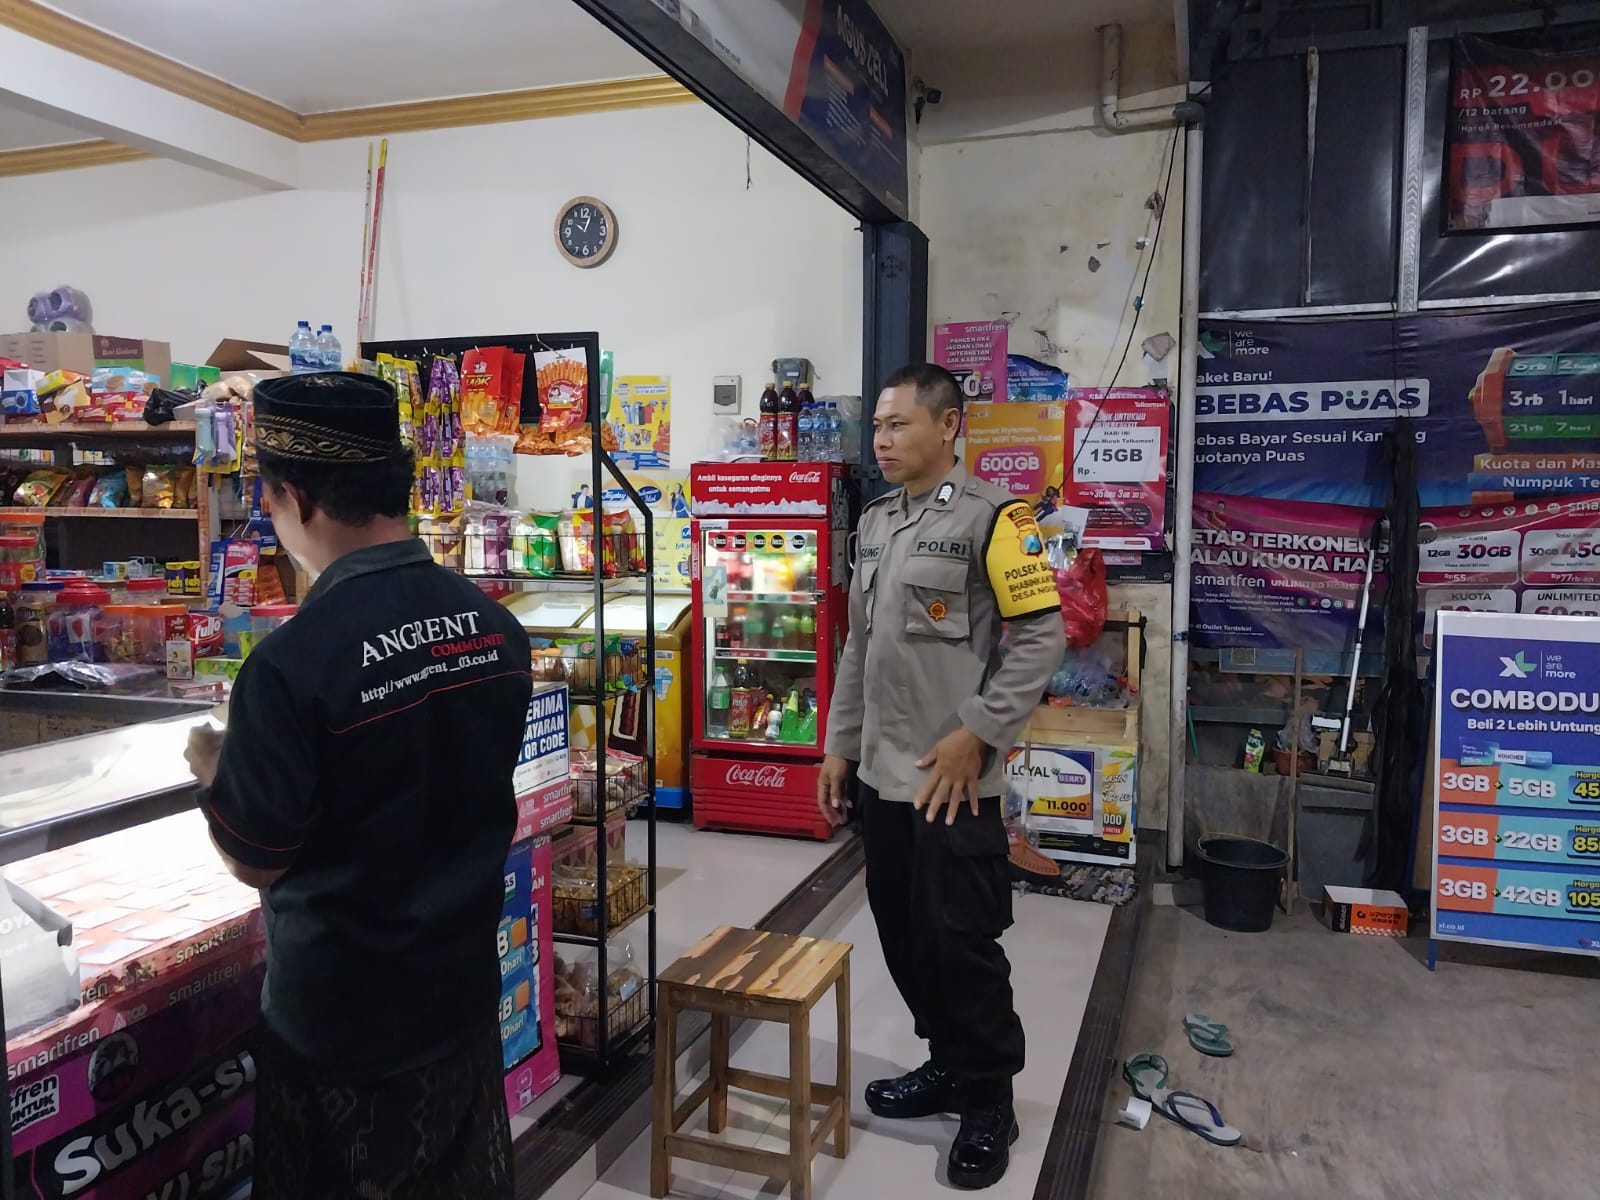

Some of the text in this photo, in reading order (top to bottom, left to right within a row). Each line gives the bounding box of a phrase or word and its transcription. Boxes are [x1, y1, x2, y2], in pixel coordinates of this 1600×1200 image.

[1460, 88, 1481, 100] RP
[1459, 105, 1527, 117] /12 batang
[580, 208, 590, 219] 12
[565, 227, 572, 238] 9
[600, 226, 606, 236] 3
[582, 245, 590, 256] 6
[965, 324, 1006, 333] smartfren
[1235, 330, 1254, 338] we
[1235, 338, 1255, 347] are
[1235, 346, 1270, 355] more
[1514, 361, 1547, 371] 6rb
[1197, 371, 1272, 383] aket Baru!
[1195, 391, 1310, 415] BEBAS
[1509, 390, 1543, 406] 3rb
[1197, 434, 1235, 446] ebas
[1240, 433, 1287, 447] Bayar
[1292, 431, 1347, 443] Sesuai
[1090, 448, 1143, 462] 15GB
[1196, 450, 1305, 465] uotanya Puas
[1480, 458, 1530, 470] Kuota
[1536, 458, 1566, 469] dan
[1077, 467, 1090, 475] Rp
[1503, 476, 1574, 490] Numpuk
[1191, 529, 1246, 546] ETAP
[917, 541, 967, 556] POLRI
[1427, 544, 1512, 559] 12GB 30GB
[1529, 547, 1559, 556] 30GB
[1191, 549, 1247, 567] ALAU
[1252, 551, 1328, 571] KUOTA
[1004, 562, 1039, 581] POLSEK
[1195, 573, 1324, 590] smartfren UNLIMITED
[1011, 589, 1036, 602] DESA
[1451, 593, 1492, 601] KUOTA
[195, 617, 221, 644] fullo
[1546, 662, 1563, 670] are
[1545, 671, 1576, 679] more
[526, 693, 564, 722] ERIMA
[1467, 718, 1600, 735] Beli 2 Lebih Untung
[524, 732, 565, 759] QR CODE
[1497, 753, 1524, 761] VOUCHER
[725, 763, 790, 787] Coca-Cola
[1060, 774, 1085, 783] BERRY
[1442, 772, 1557, 798] 3GB 5GB
[1441, 825, 1562, 851] 3GB 22GB
[1574, 880, 1600, 888] Harga
[1439, 878, 1562, 907] 3GB 42GB
[168, 962, 241, 1006] smartfren
[8, 1026, 100, 1081] smartfren
